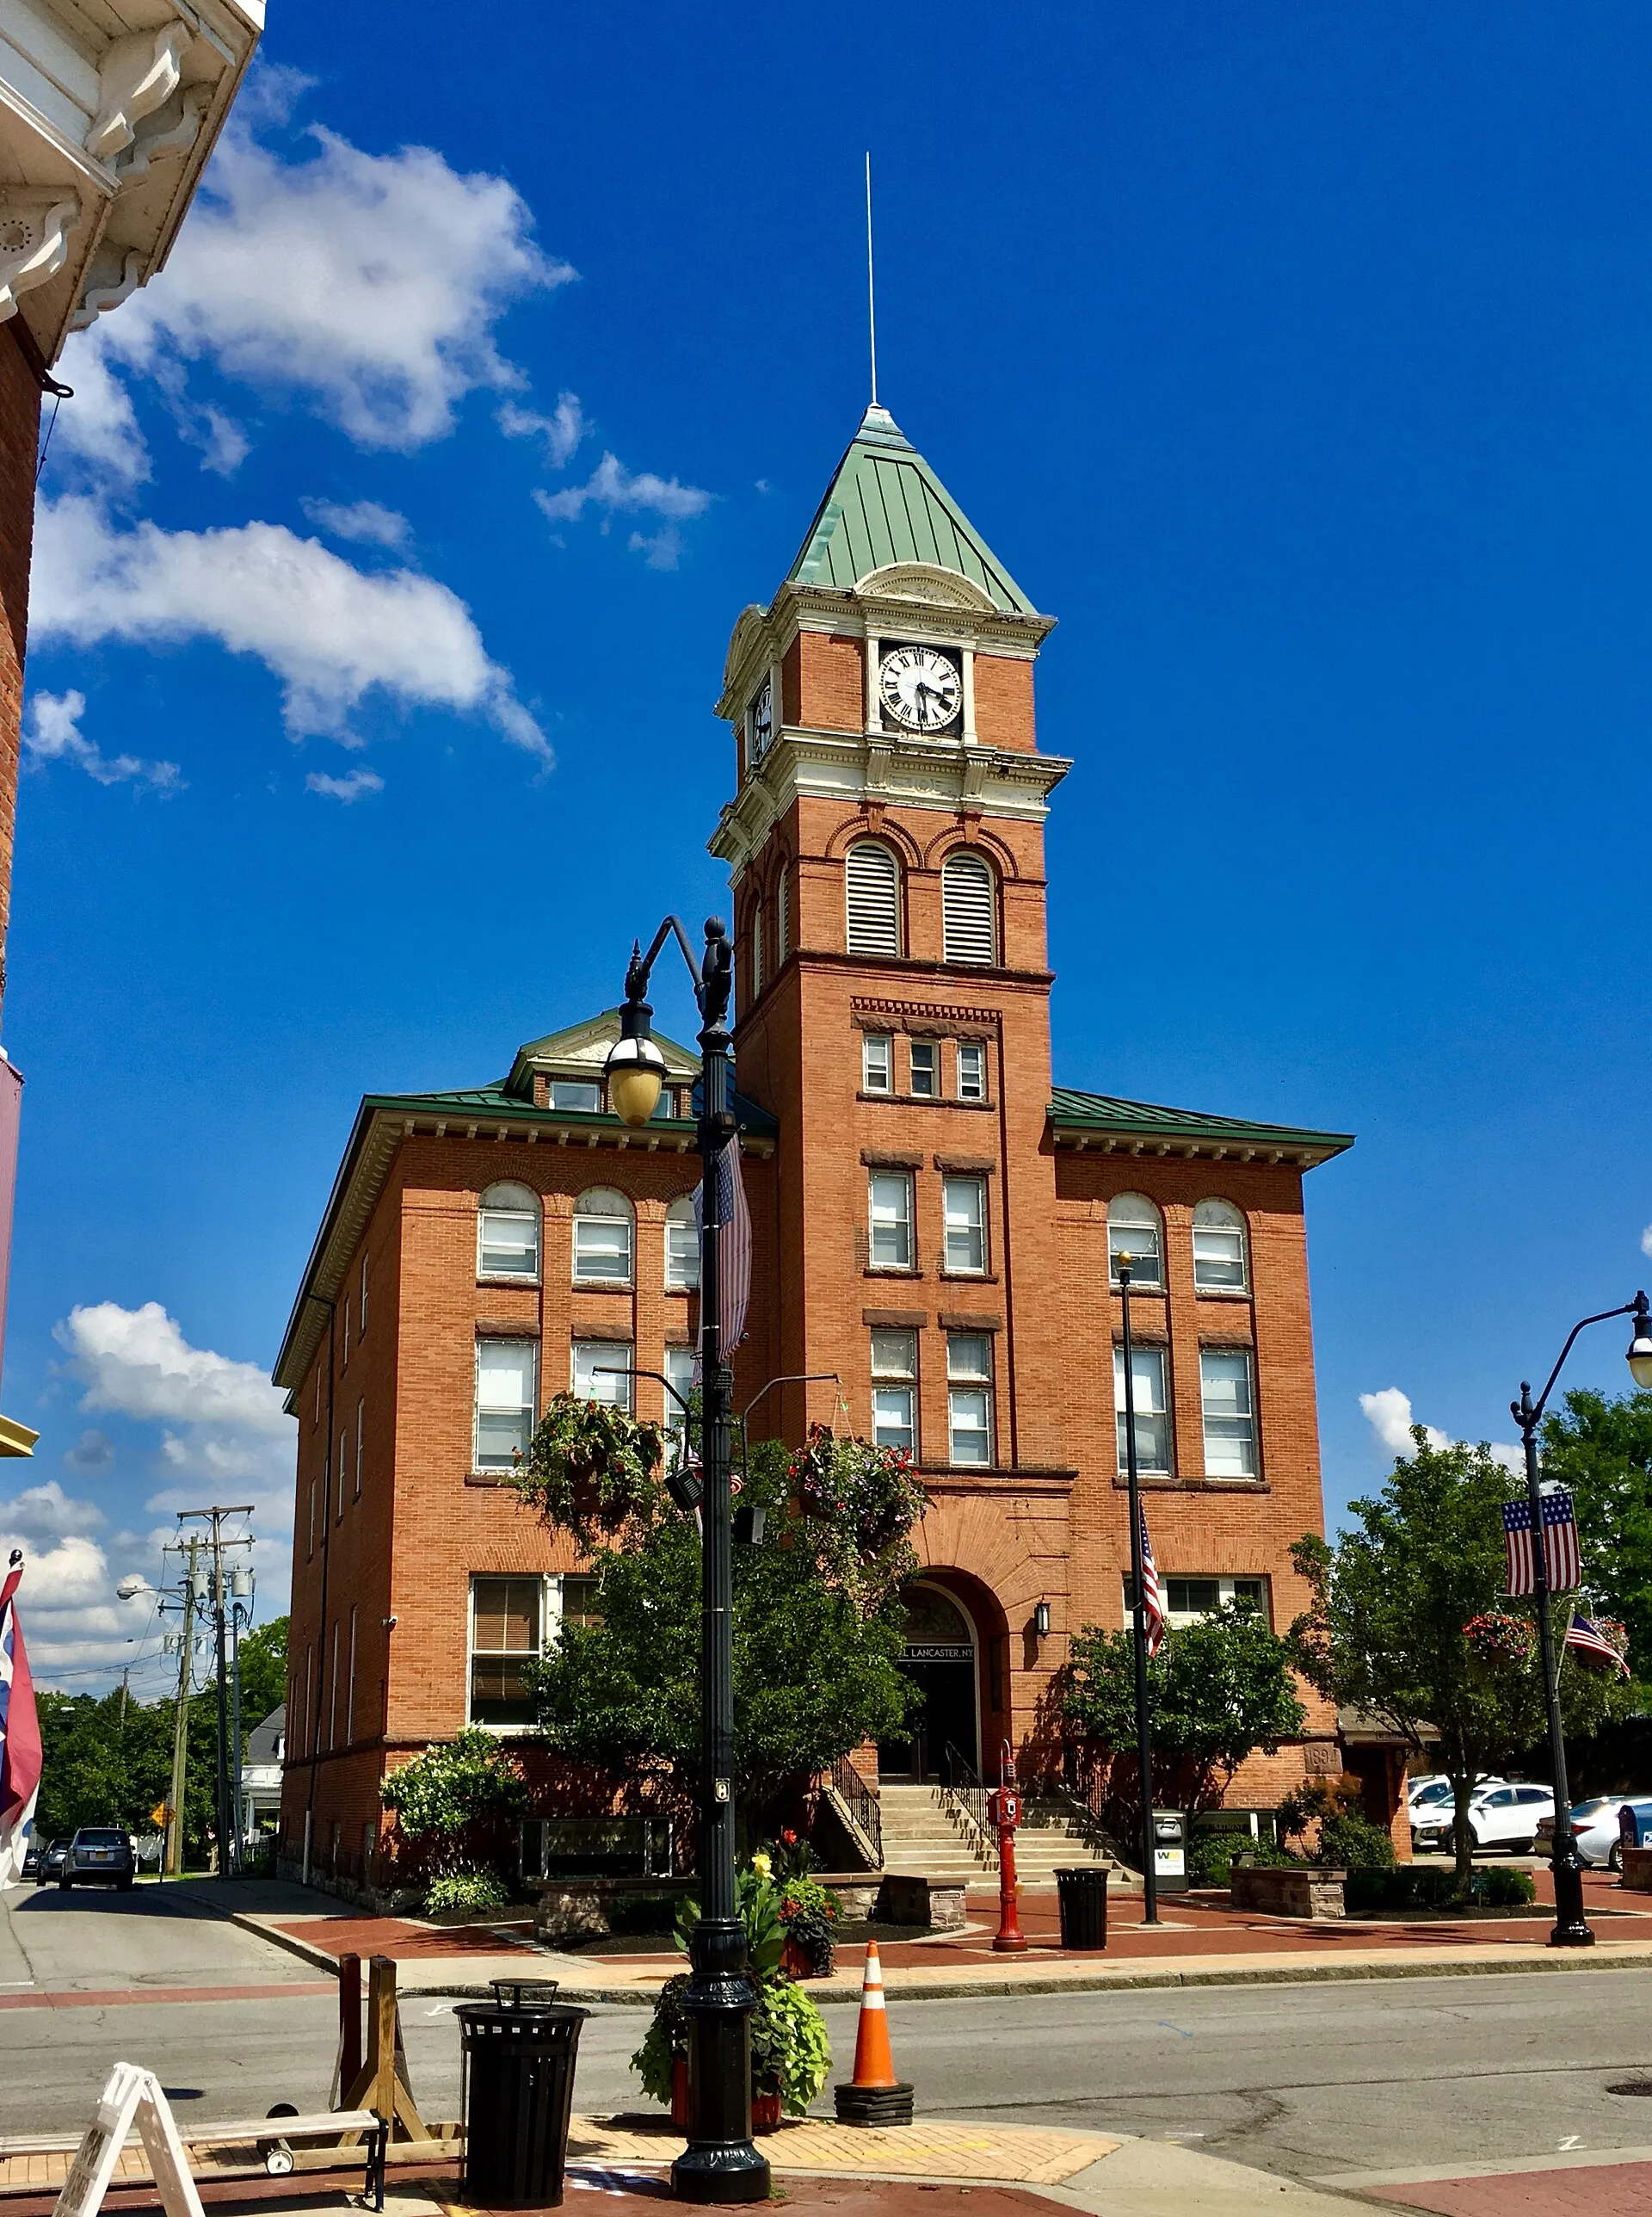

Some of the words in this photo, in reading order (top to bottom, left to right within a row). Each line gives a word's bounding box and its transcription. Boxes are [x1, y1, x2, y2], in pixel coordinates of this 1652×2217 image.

[898, 655, 910, 670] XI
[913, 653, 925, 667] XII
[888, 666, 901, 677] X
[1308, 1748, 1337, 1764] 1894
